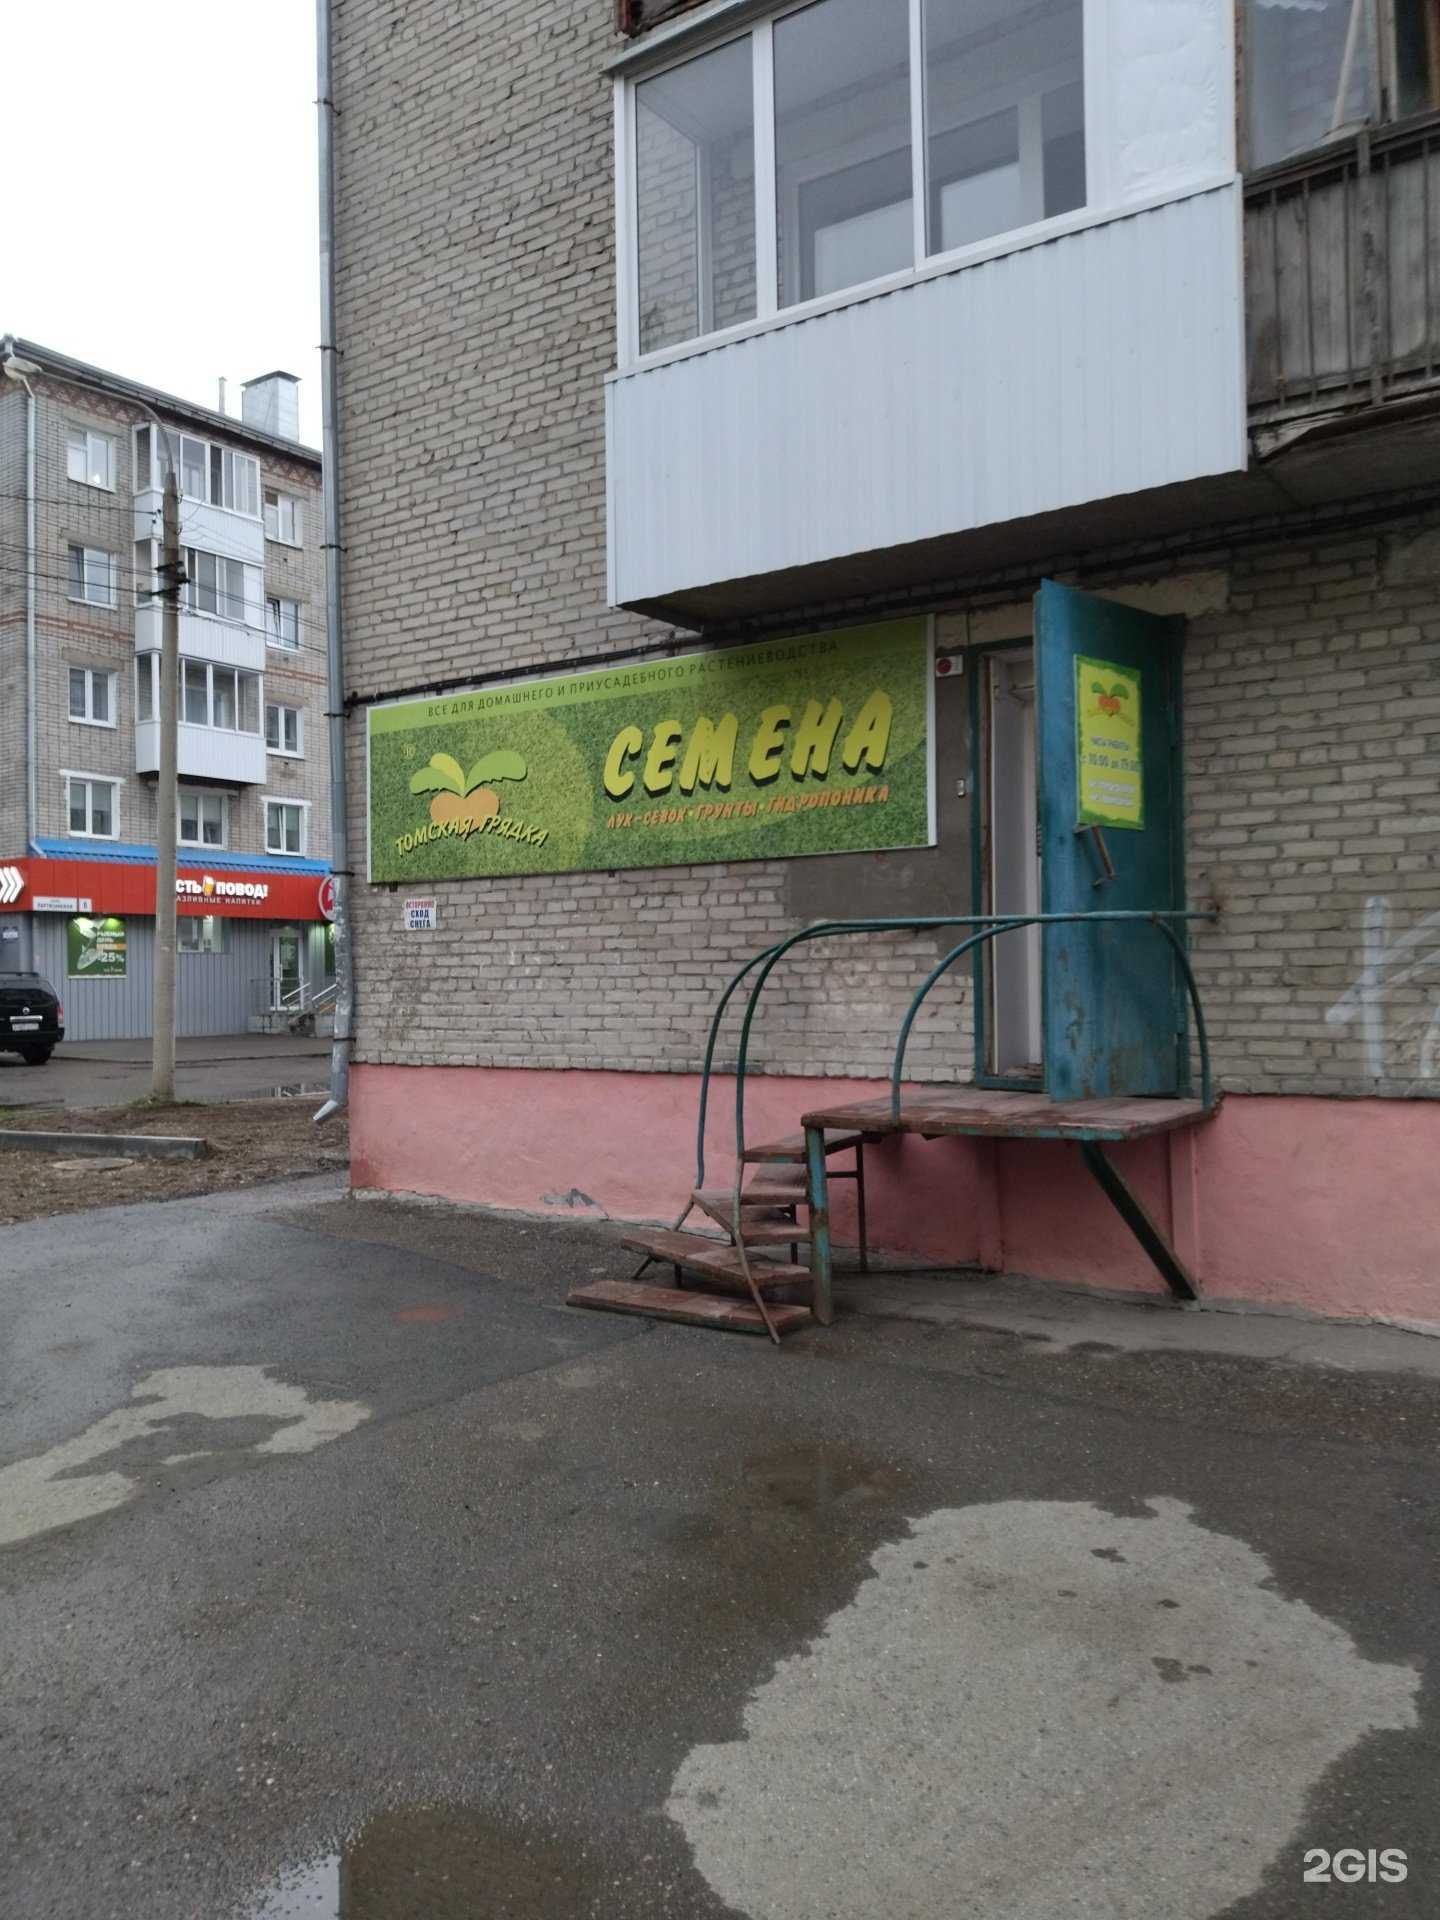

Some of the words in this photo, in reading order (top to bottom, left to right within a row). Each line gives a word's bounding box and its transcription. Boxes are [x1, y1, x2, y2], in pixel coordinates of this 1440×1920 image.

[428, 705, 448, 717] ВСЕ
[451, 702, 474, 714] ДЛЯ
[478, 687, 553, 710] ДОМАШНЕГО
[558, 684, 565, 696] И
[570, 665, 685, 694] ПРИУСАДЕБНОГО
[689, 640, 838, 674] РАСТЕНИЕВОДСТВА
[603, 688, 893, 802] СЕМЕНА
[395, 816, 473, 857] ТОМСКАЯ
[479, 815, 549, 848] ГРЯДКА
[175, 879, 202, 894] СТЬ
[216, 881, 268, 899] ПОВОД!
[176, 895, 222, 904] АЗЛИВНЫЕ
[410, 909, 430, 918] СХОД
[410, 920, 431, 928] СНЕГА
